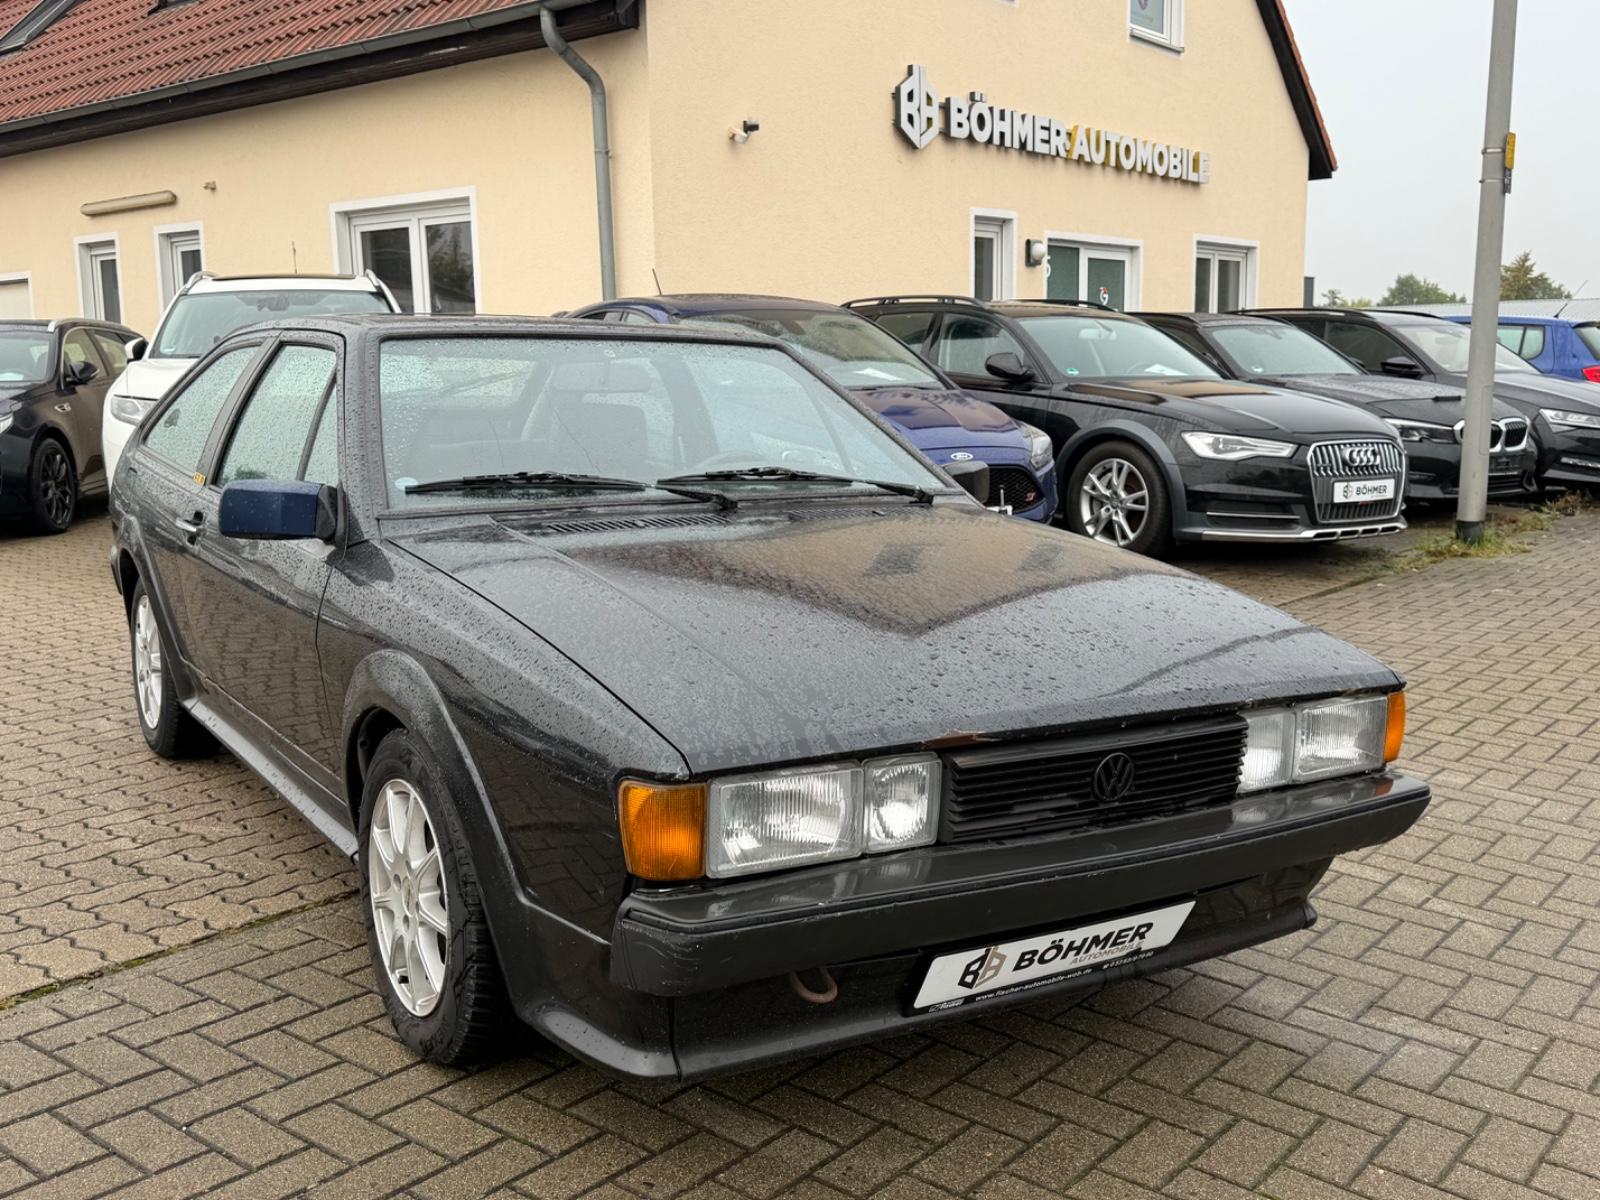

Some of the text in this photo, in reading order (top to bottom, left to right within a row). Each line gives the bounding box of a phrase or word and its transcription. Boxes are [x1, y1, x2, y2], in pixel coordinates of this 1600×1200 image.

[945, 91, 1210, 185] BÖHMER AUTOMOBILE
[1355, 484, 1388, 496] BÖHMER
[1012, 922, 1154, 972] BÖHMER
[1069, 941, 1145, 966] AUTOMOBILE
